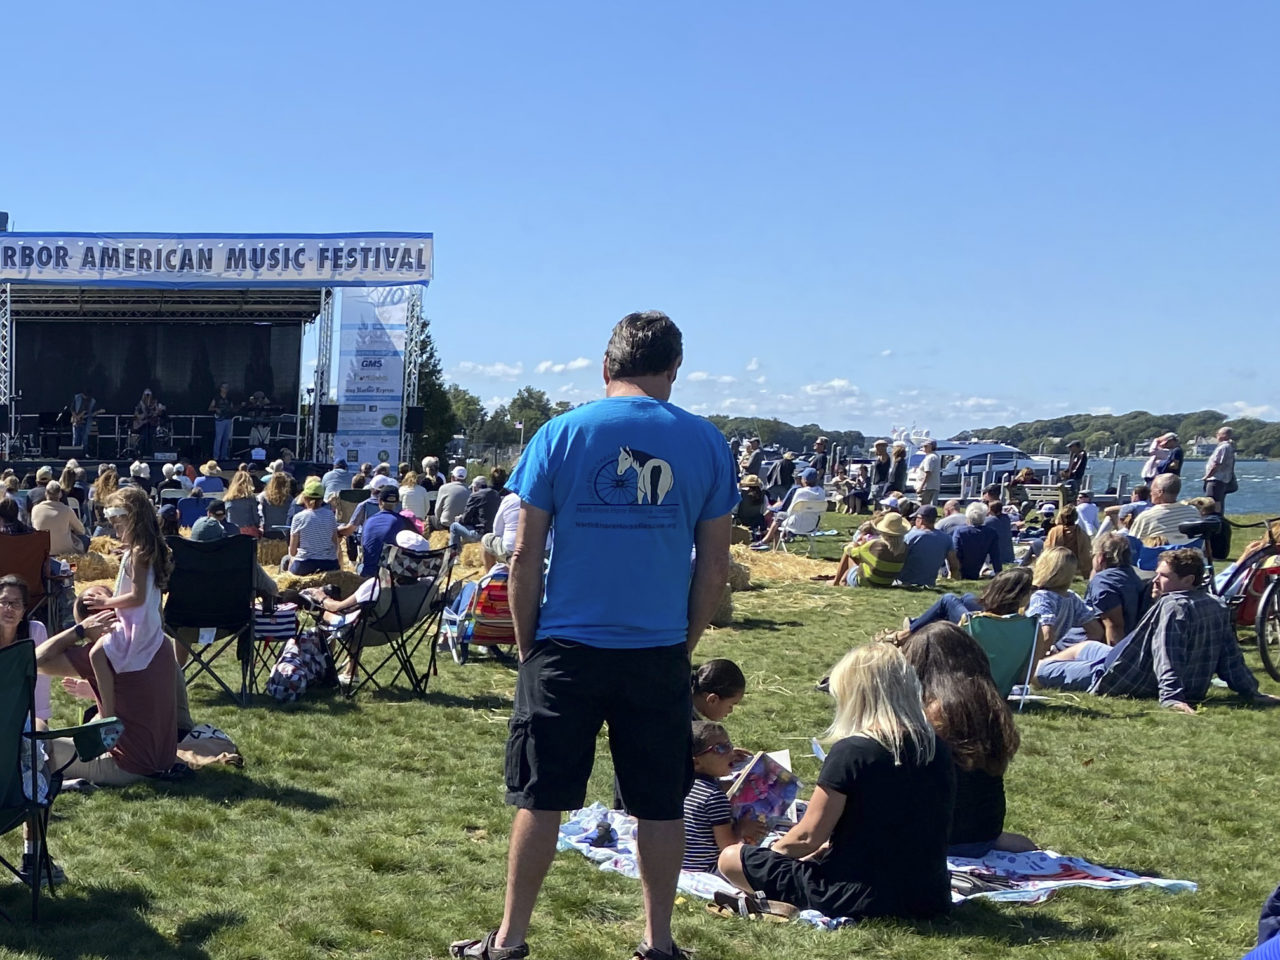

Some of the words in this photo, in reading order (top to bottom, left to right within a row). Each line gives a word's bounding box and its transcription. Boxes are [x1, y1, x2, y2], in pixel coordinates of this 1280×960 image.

[81, 246, 213, 271] AMERICAN
[224, 247, 306, 271] MUSIC
[317, 247, 427, 271] FESTIVAL
[361, 360, 383, 368] GMS
